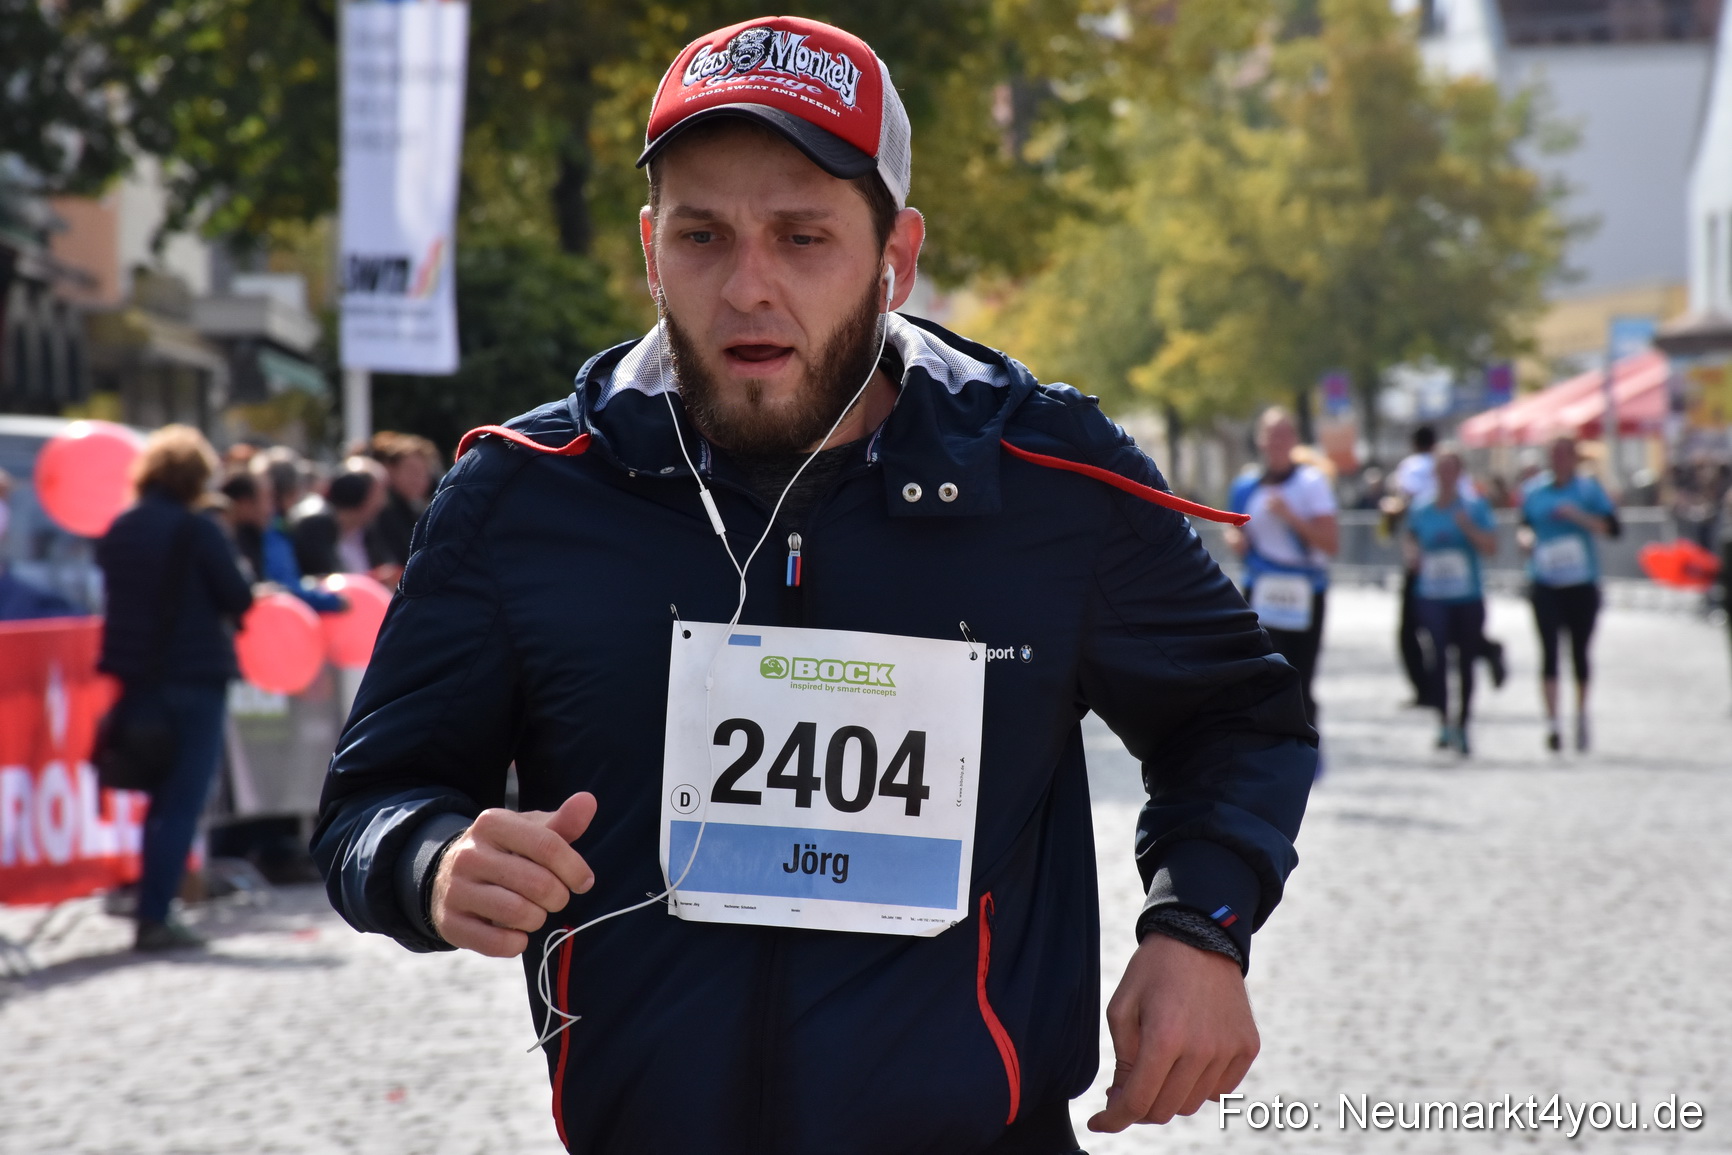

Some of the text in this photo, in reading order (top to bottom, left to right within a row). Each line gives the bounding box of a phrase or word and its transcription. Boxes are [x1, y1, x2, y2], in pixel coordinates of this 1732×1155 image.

[682, 31, 863, 108] Gas Monkey
[705, 74, 823, 95] Garage
[684, 88, 725, 103] BLOOD,
[726, 84, 769, 92] SWEAT
[771, 87, 798, 98] AND
[799, 94, 841, 118] BEERS!
[985, 646, 1015, 662] port
[792, 658, 895, 687] BOCK
[790, 682, 897, 697] inspired by smart concepts
[710, 717, 930, 817] 2404
[680, 791, 691, 808] D
[782, 843, 850, 884] Jörg
